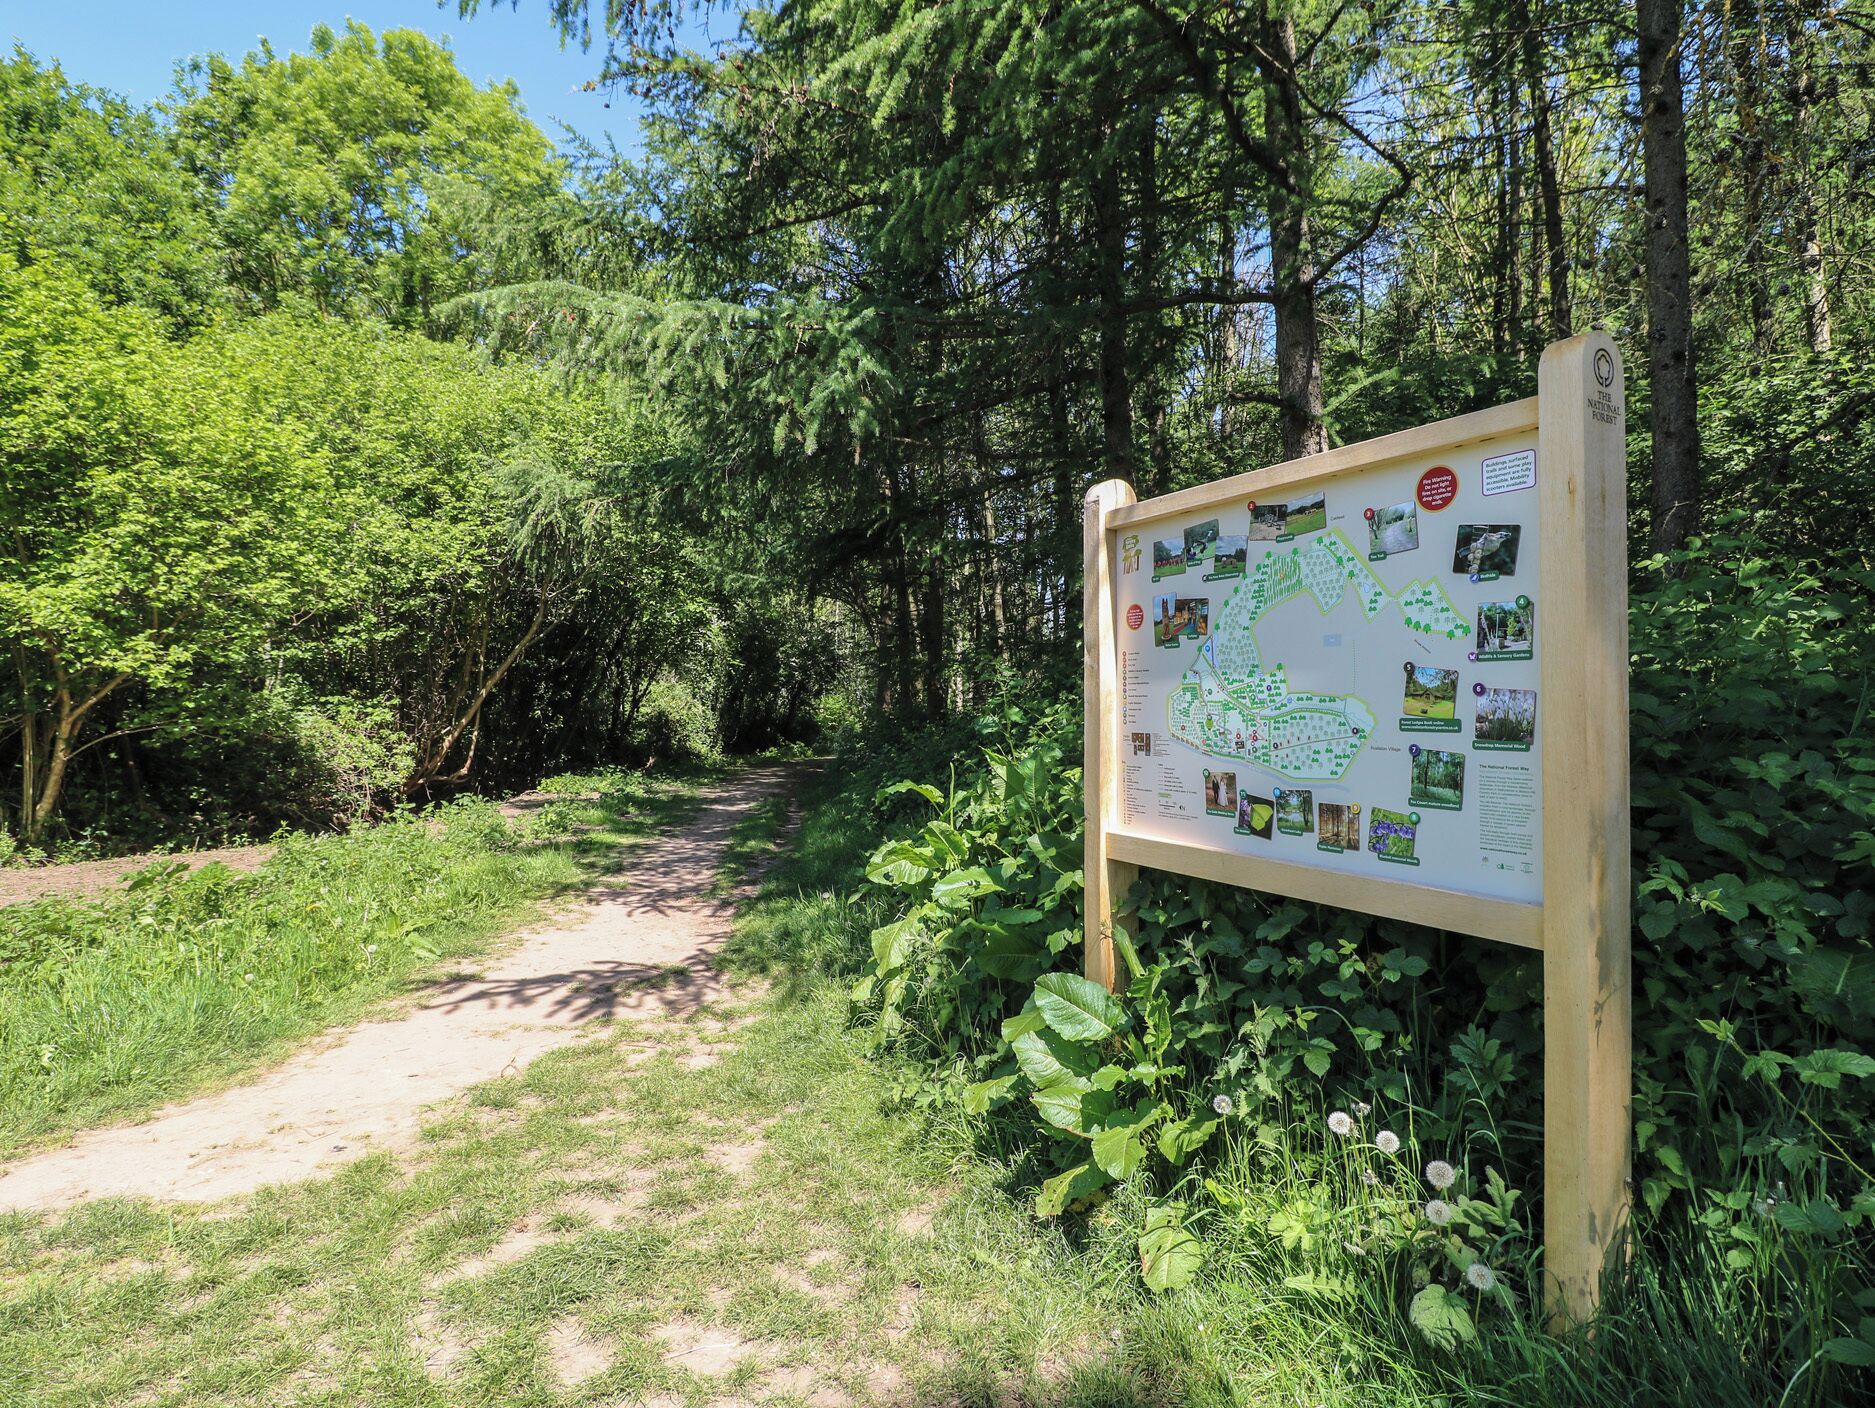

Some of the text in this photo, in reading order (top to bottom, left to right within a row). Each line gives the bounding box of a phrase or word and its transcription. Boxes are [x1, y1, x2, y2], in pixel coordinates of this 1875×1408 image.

[1597, 390, 1611, 402] THE
[1588, 398, 1621, 416] NATIONAL
[1592, 410, 1617, 425] FOREST
[1432, 475, 1452, 483] Warning
[1486, 472, 1510, 480] equipment
[1433, 492, 1452, 500] cigarette
